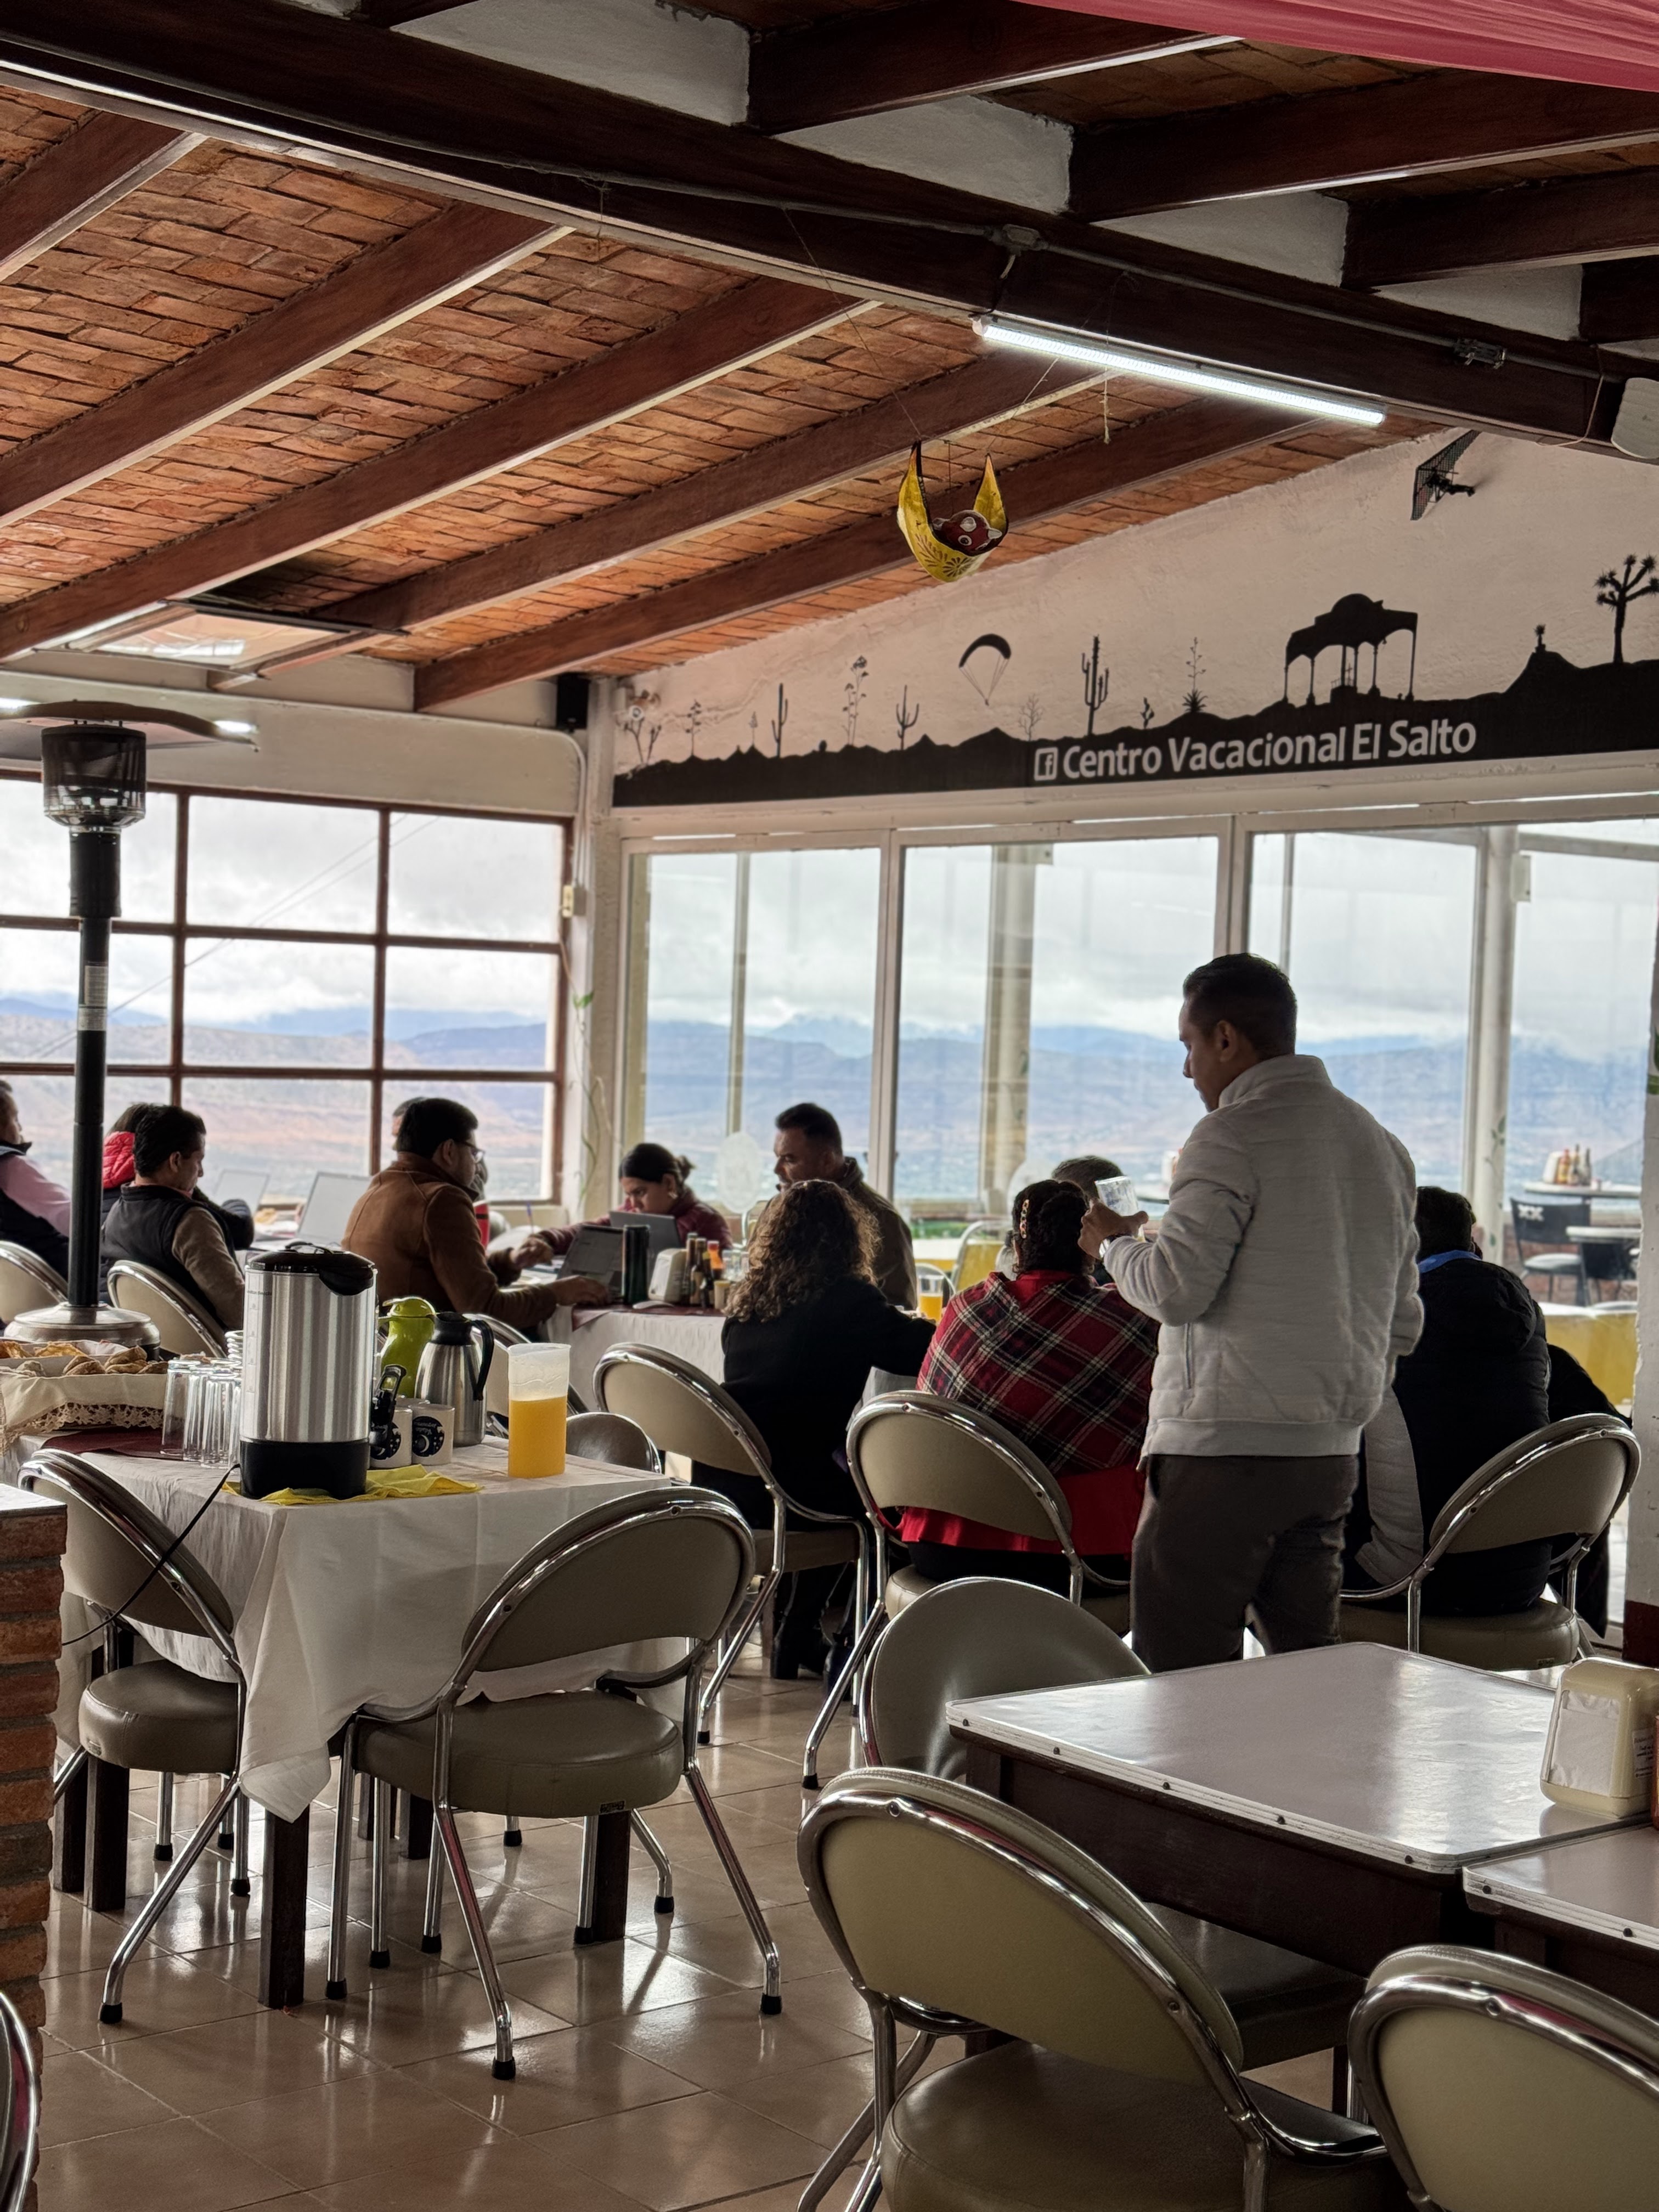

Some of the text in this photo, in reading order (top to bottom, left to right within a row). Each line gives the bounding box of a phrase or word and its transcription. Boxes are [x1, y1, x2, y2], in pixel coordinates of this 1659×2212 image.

[1063, 742, 1163, 778] Centro
[1168, 727, 1346, 772] Vacacional
[1352, 723, 1381, 761] El
[1387, 718, 1476, 758] Salto
